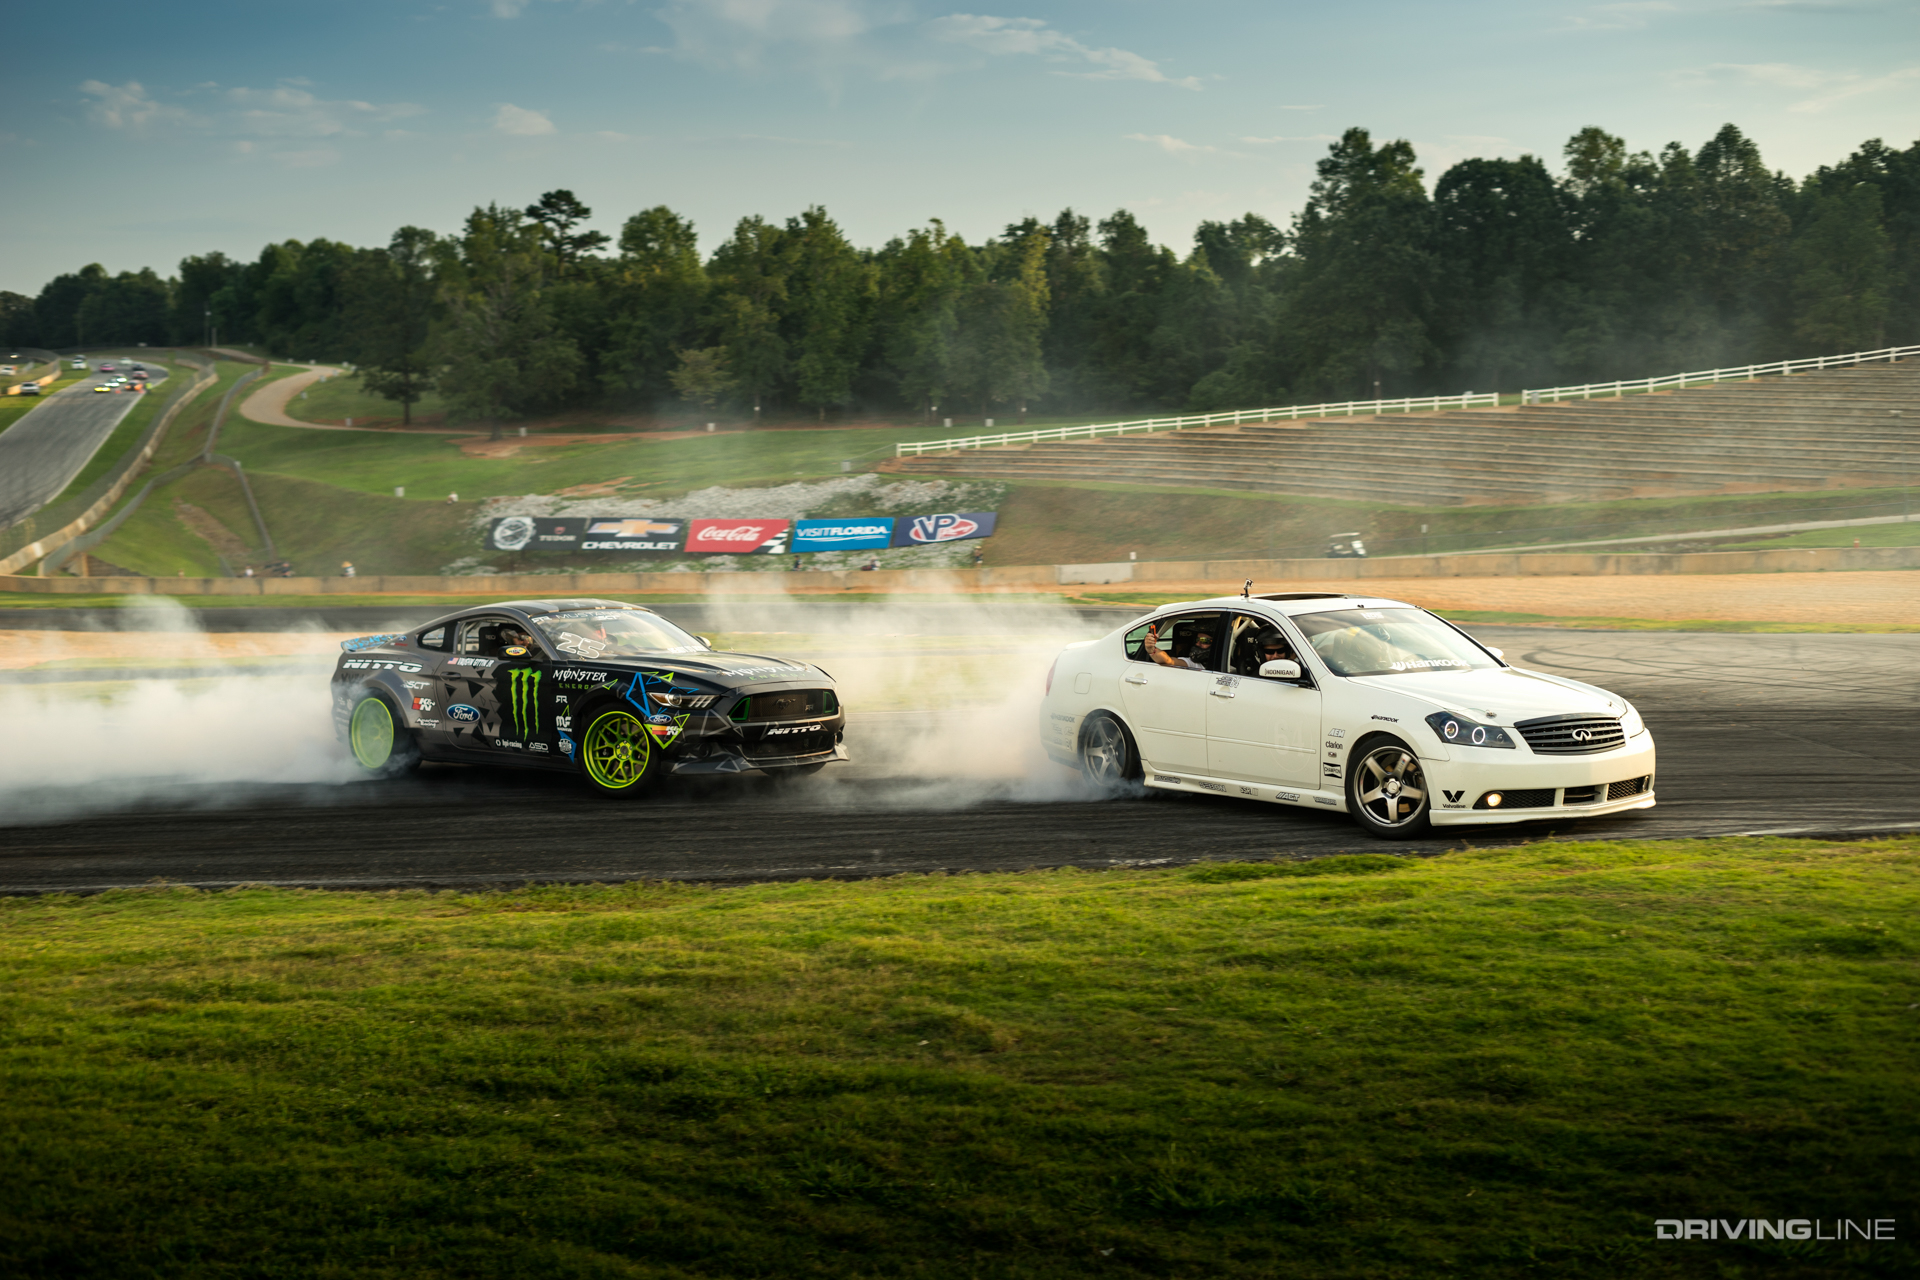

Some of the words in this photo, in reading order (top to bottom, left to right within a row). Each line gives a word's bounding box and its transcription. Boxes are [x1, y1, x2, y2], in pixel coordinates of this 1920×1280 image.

[697, 526, 765, 541] Coca-Cola
[914, 514, 960, 540] VP
[581, 541, 679, 550] CHEVROLET
[556, 632, 606, 659] 25
[342, 659, 423, 673] NITTO
[453, 706, 474, 720] Ford
[767, 724, 822, 736] NITTO
[1328, 728, 1346, 738] AEM
[1325, 740, 1343, 750] clarion
